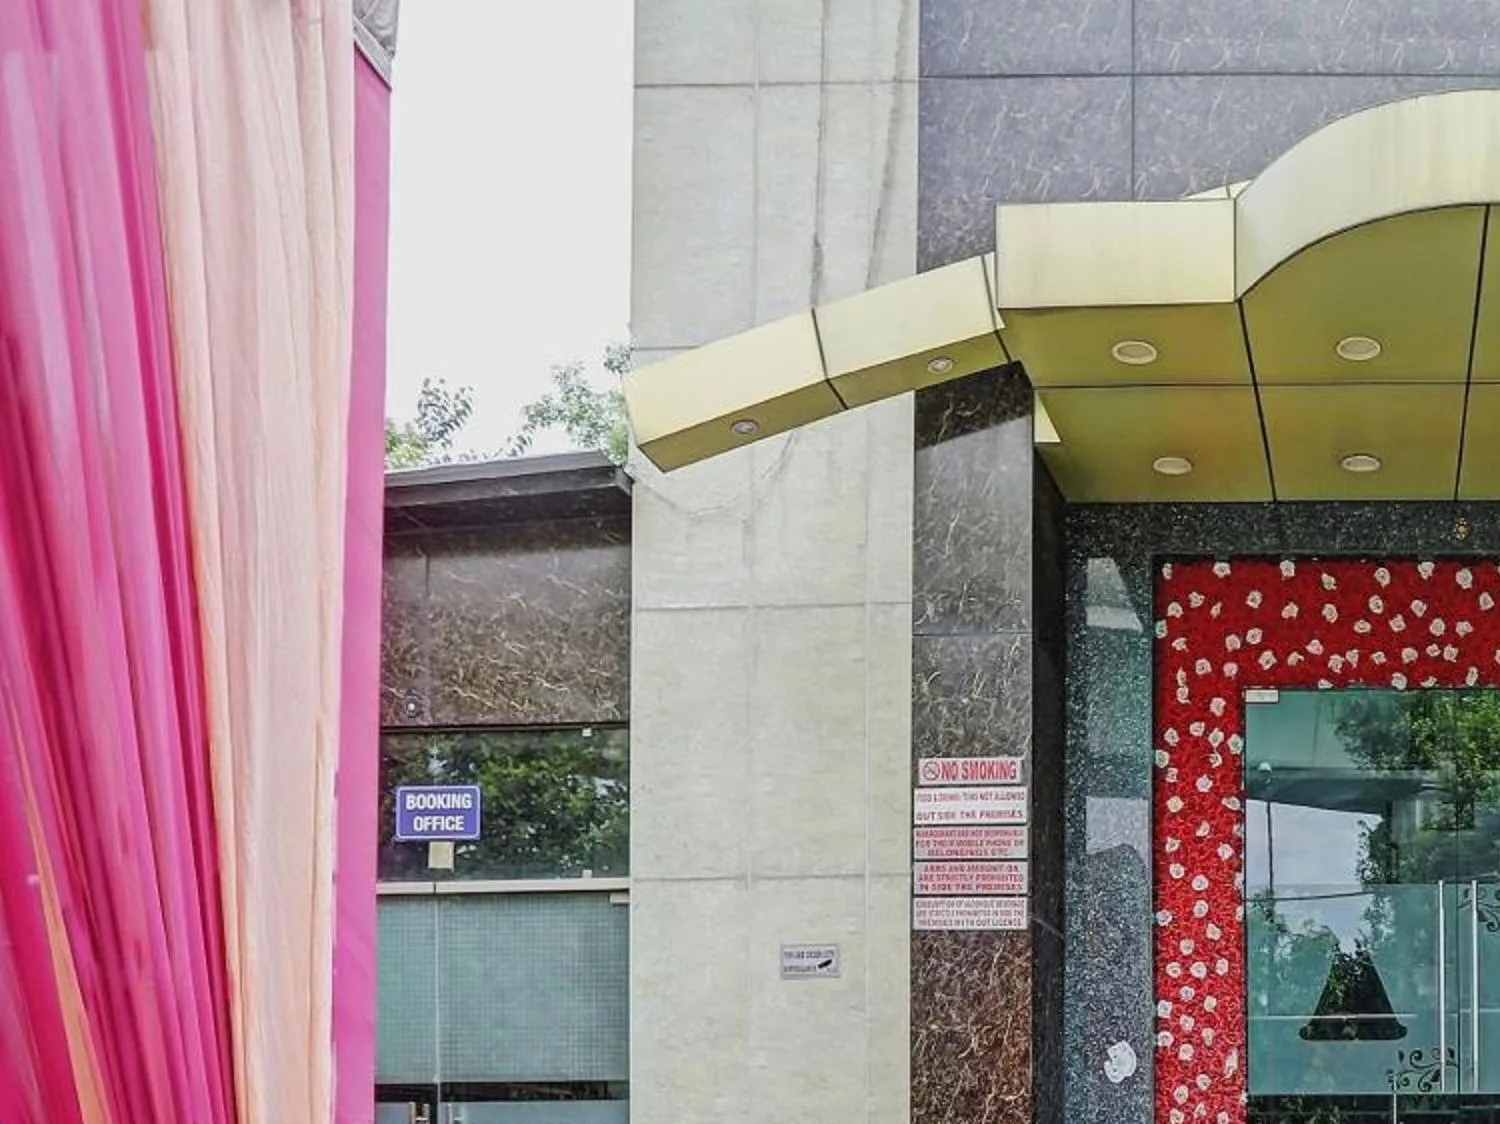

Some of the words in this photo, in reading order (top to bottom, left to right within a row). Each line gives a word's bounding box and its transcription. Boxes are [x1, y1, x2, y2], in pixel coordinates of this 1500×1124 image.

[941, 760, 958, 780] NO
[962, 760, 1016, 780] SMOKING
[406, 793, 472, 810] BOOKING
[413, 815, 465, 831] OFFICE
